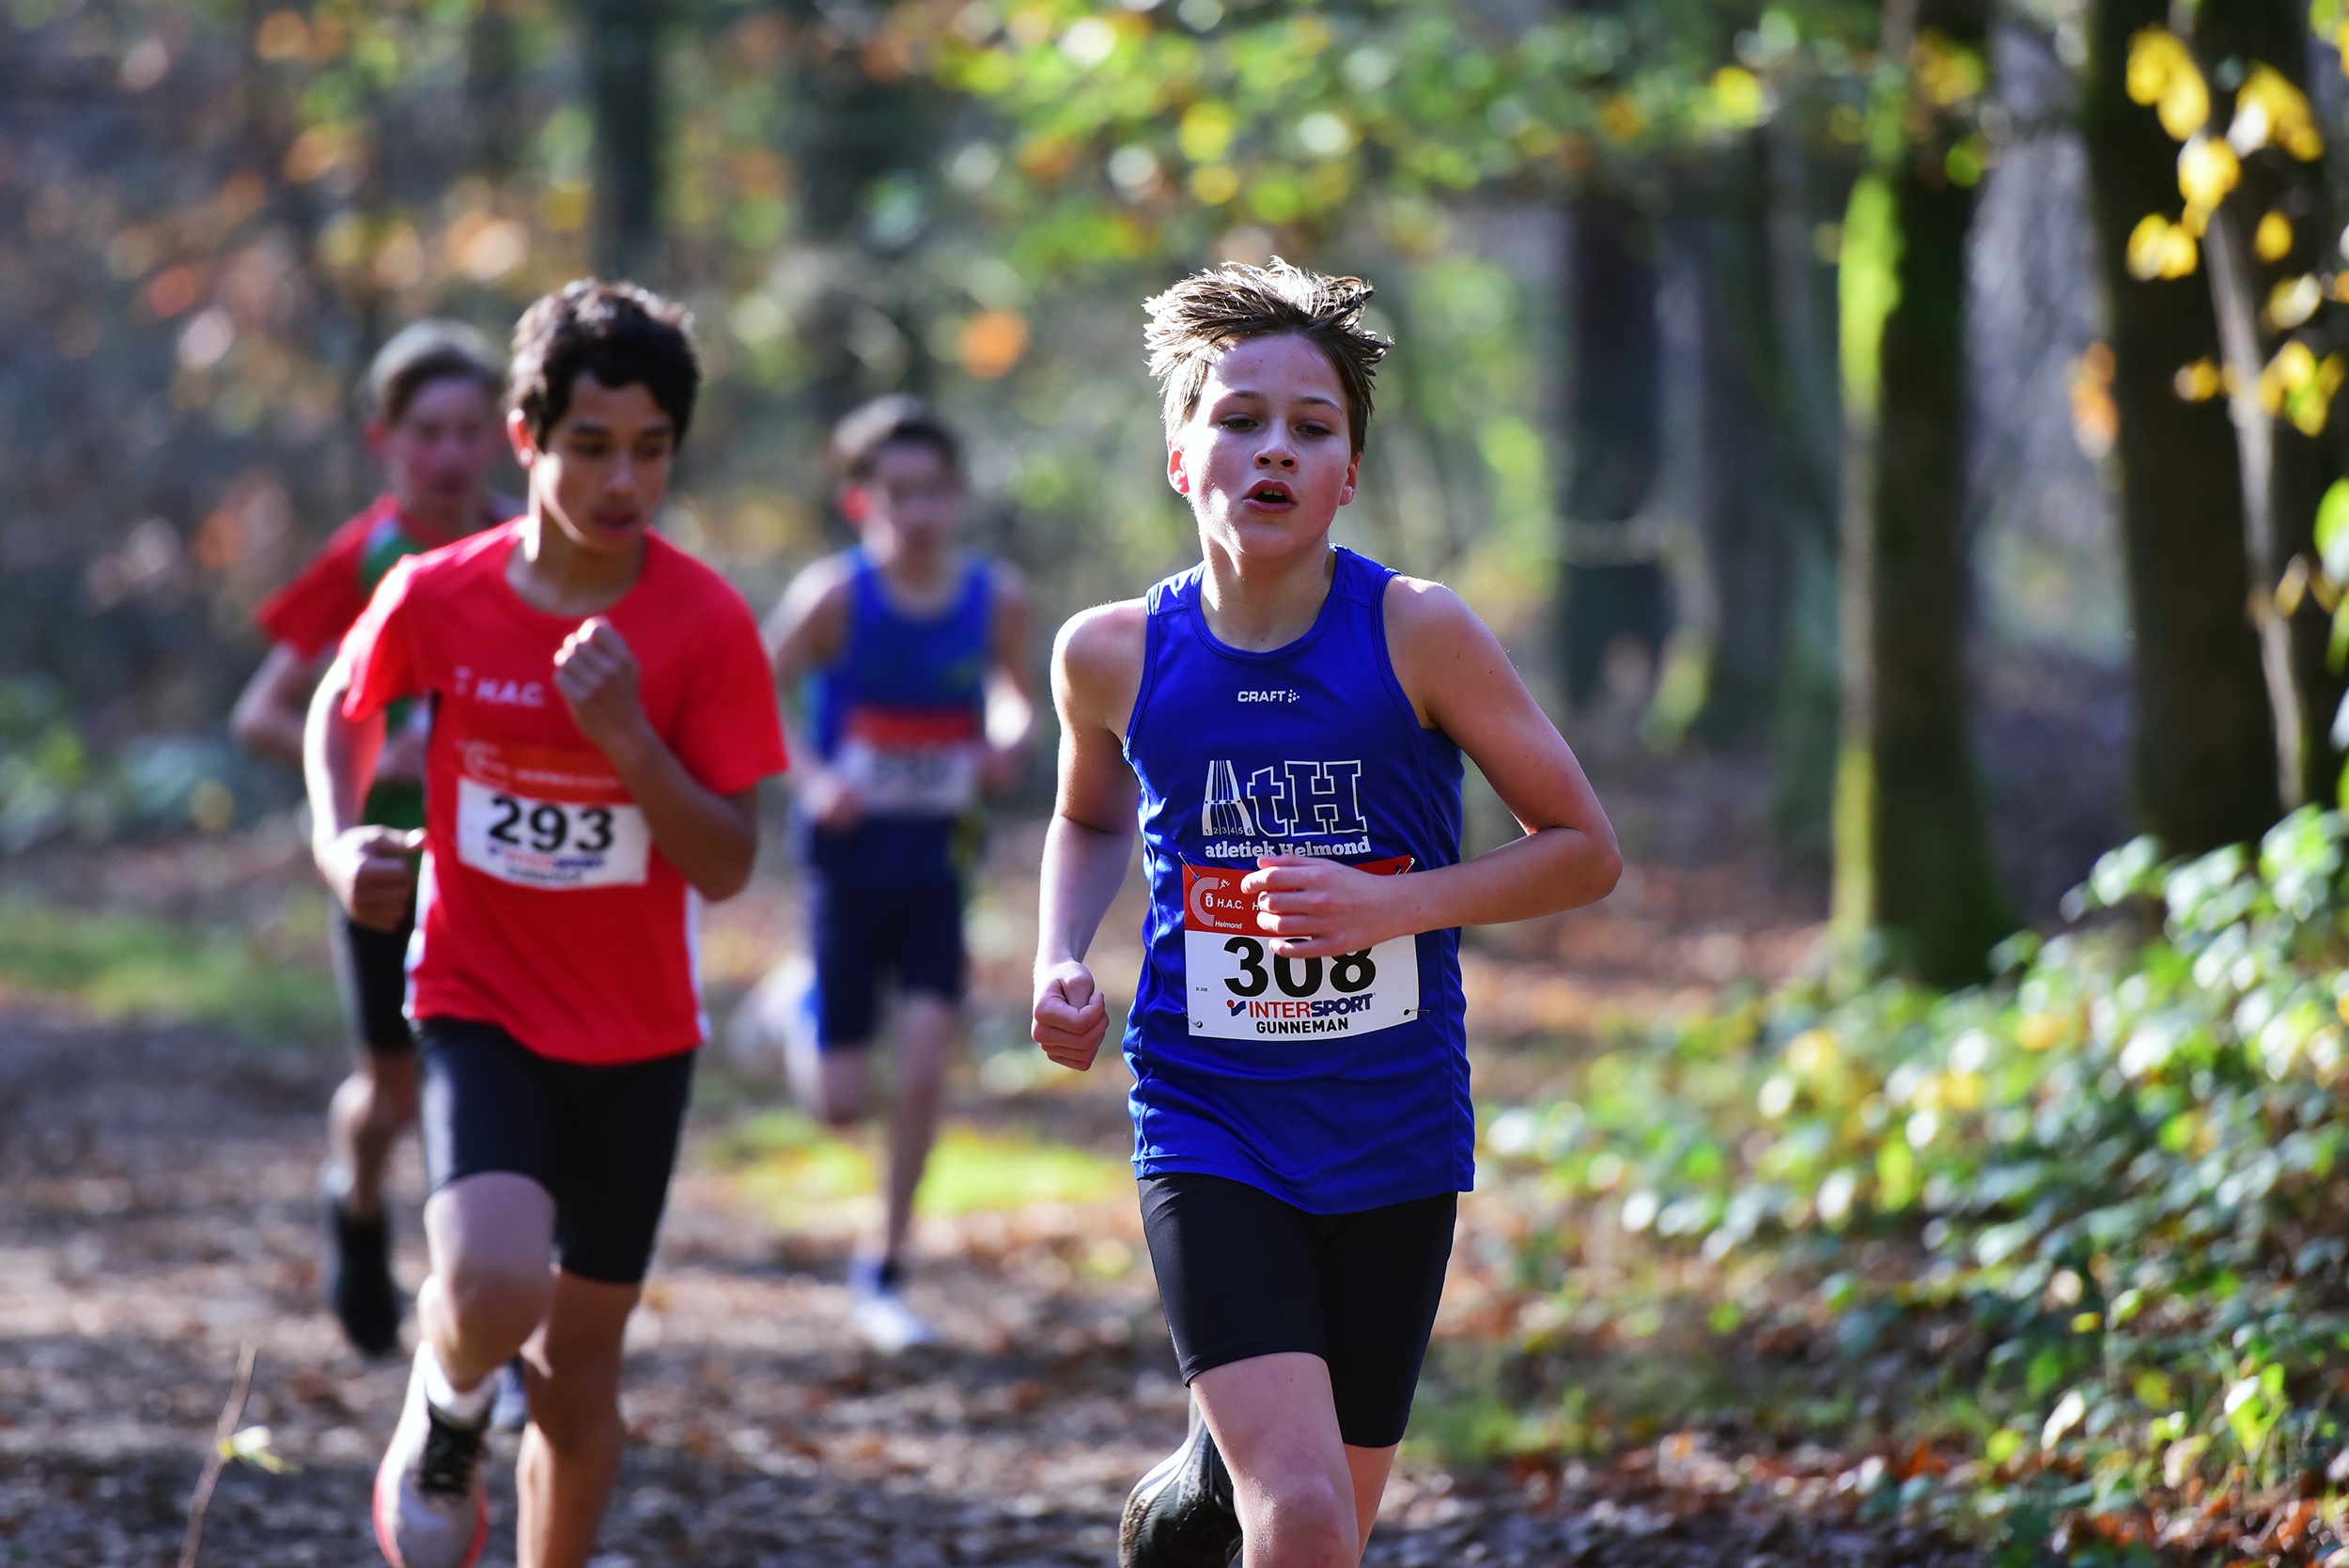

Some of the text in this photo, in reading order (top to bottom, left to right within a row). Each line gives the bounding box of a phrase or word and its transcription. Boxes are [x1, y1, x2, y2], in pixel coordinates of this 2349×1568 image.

[1237, 691, 1285, 703] CRAFT
[1202, 759, 1368, 837] AtH
[488, 795, 614, 853] 293
[1205, 835, 1372, 858] atletiek Helmond
[1217, 898, 1244, 909] H.A.C.
[1215, 921, 1242, 929] Helmond
[1223, 936, 1377, 998] 308
[1250, 993, 1373, 1018] INTERSPORT
[1256, 1017, 1348, 1033] GUNNEMAN
